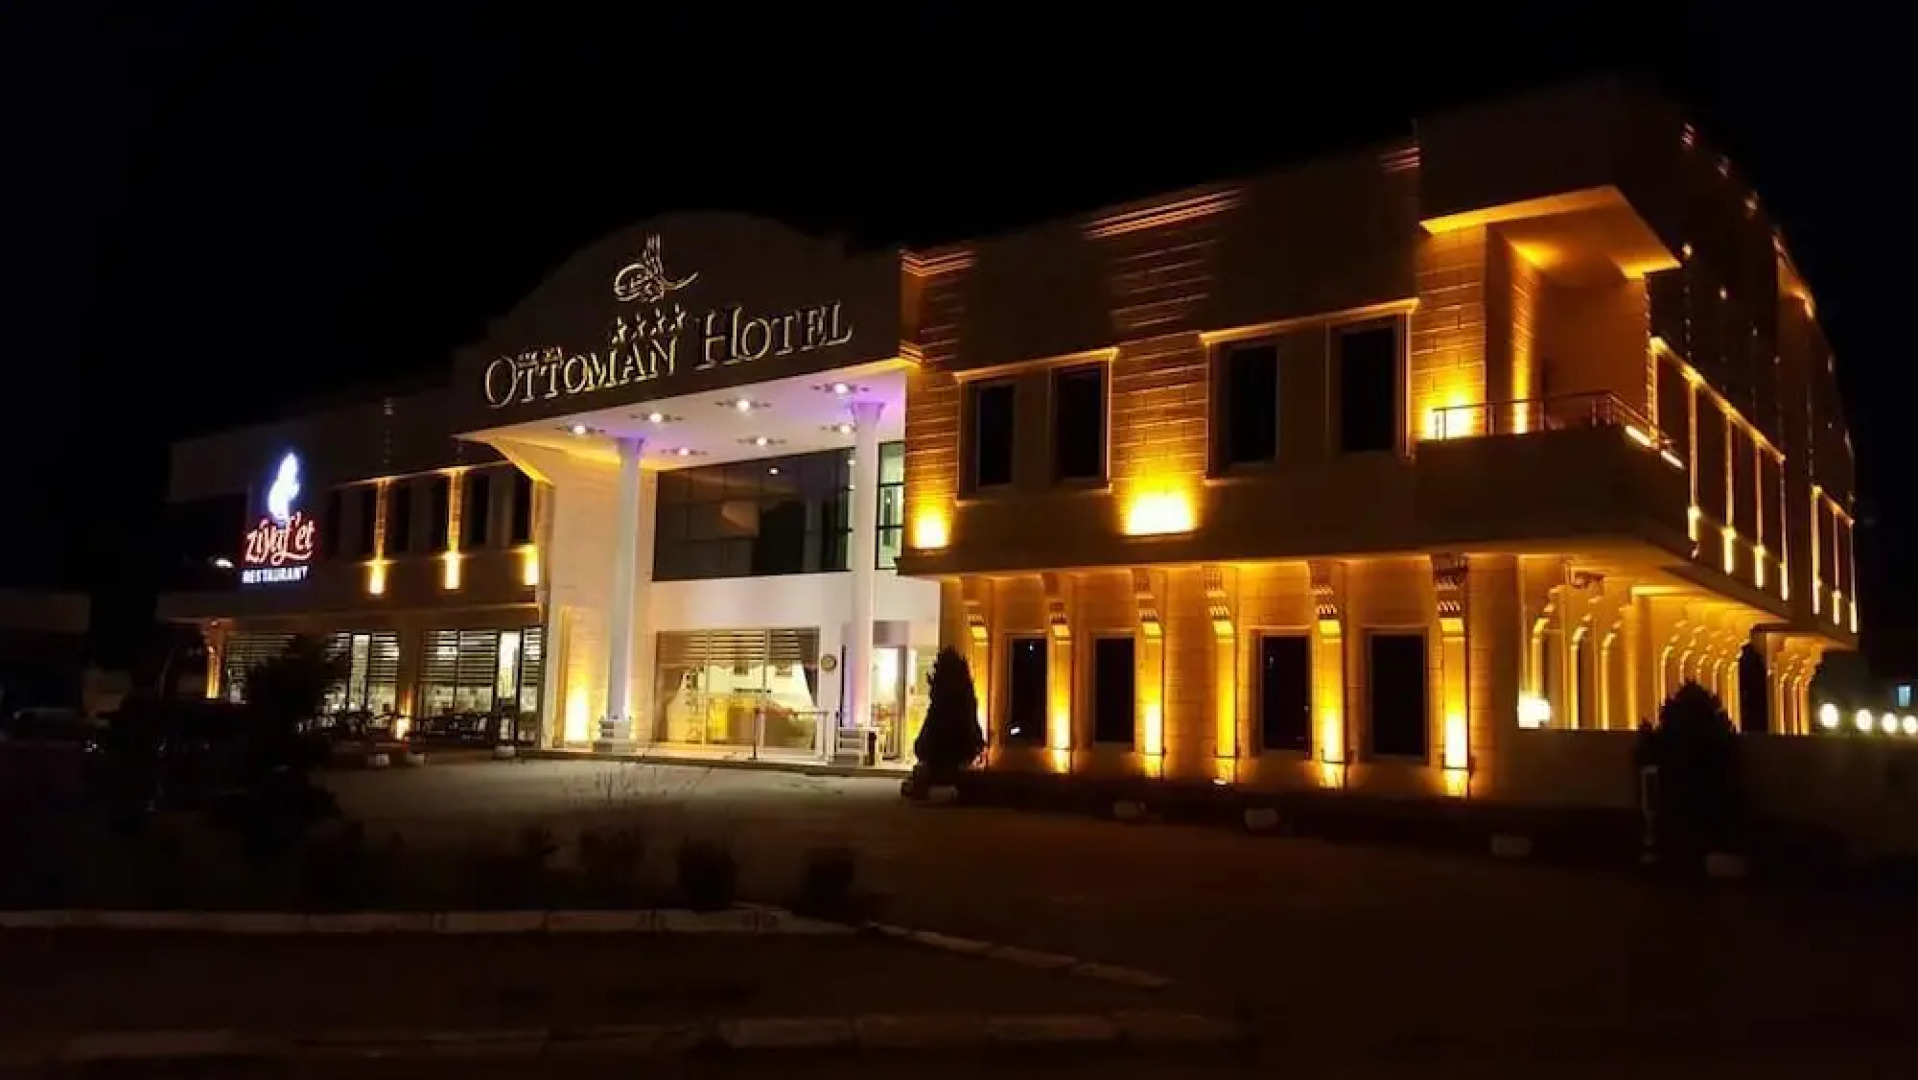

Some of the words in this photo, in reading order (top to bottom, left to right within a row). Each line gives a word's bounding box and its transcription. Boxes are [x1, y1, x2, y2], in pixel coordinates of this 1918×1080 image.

[485, 336, 677, 408] OTTOMAN
[696, 300, 853, 371] HOTEL
[242, 565, 309, 584] RESTAURANT
